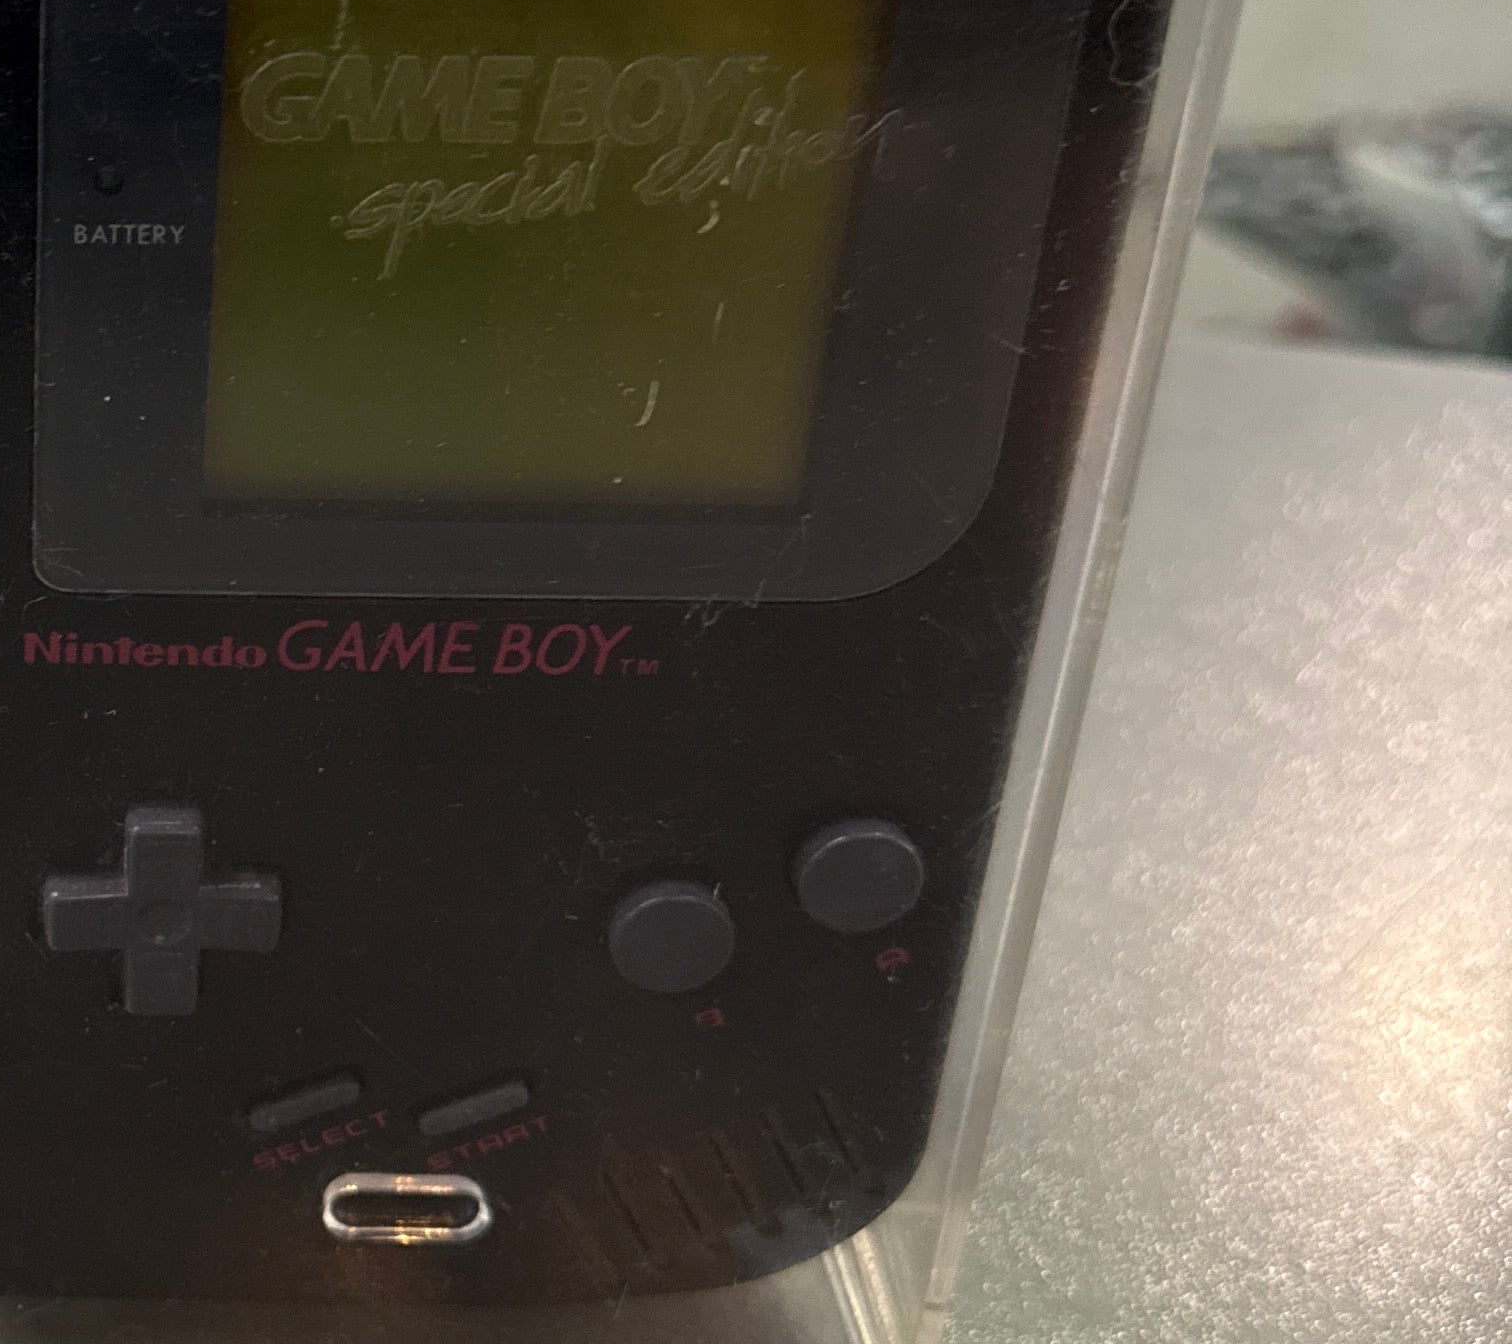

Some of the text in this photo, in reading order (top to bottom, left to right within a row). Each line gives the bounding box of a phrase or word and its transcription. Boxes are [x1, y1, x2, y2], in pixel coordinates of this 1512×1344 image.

[240, 50, 535, 144] GAME
[73, 223, 186, 245] BATTERY
[22, 630, 268, 669] Nintendo
[277, 618, 481, 675] GAME
[494, 623, 633, 677] BOY
[251, 1109, 389, 1171] SELECT
[425, 1115, 548, 1171] START
